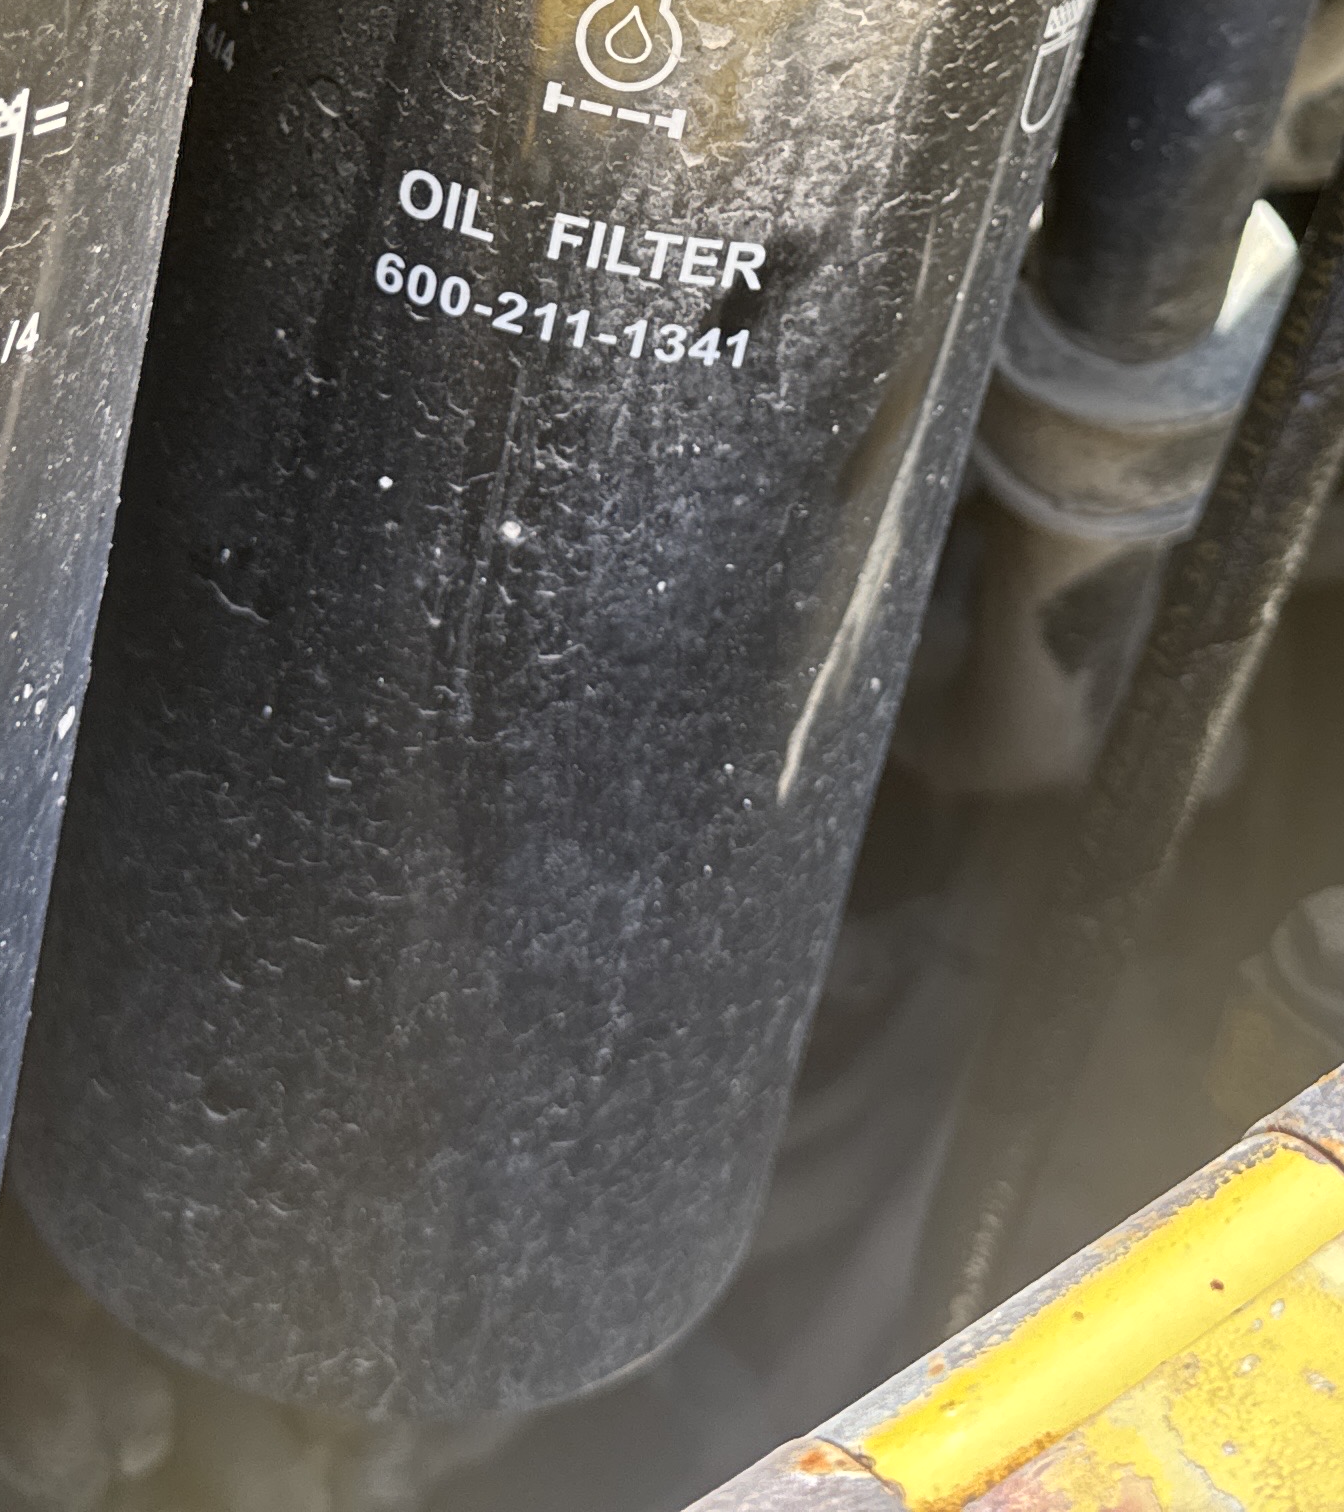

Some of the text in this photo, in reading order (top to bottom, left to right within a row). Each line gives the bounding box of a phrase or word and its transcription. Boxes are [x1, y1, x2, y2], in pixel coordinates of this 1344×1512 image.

[398, 169, 767, 292] OIL FILTER
[374, 253, 751, 369] 600-211-1341
